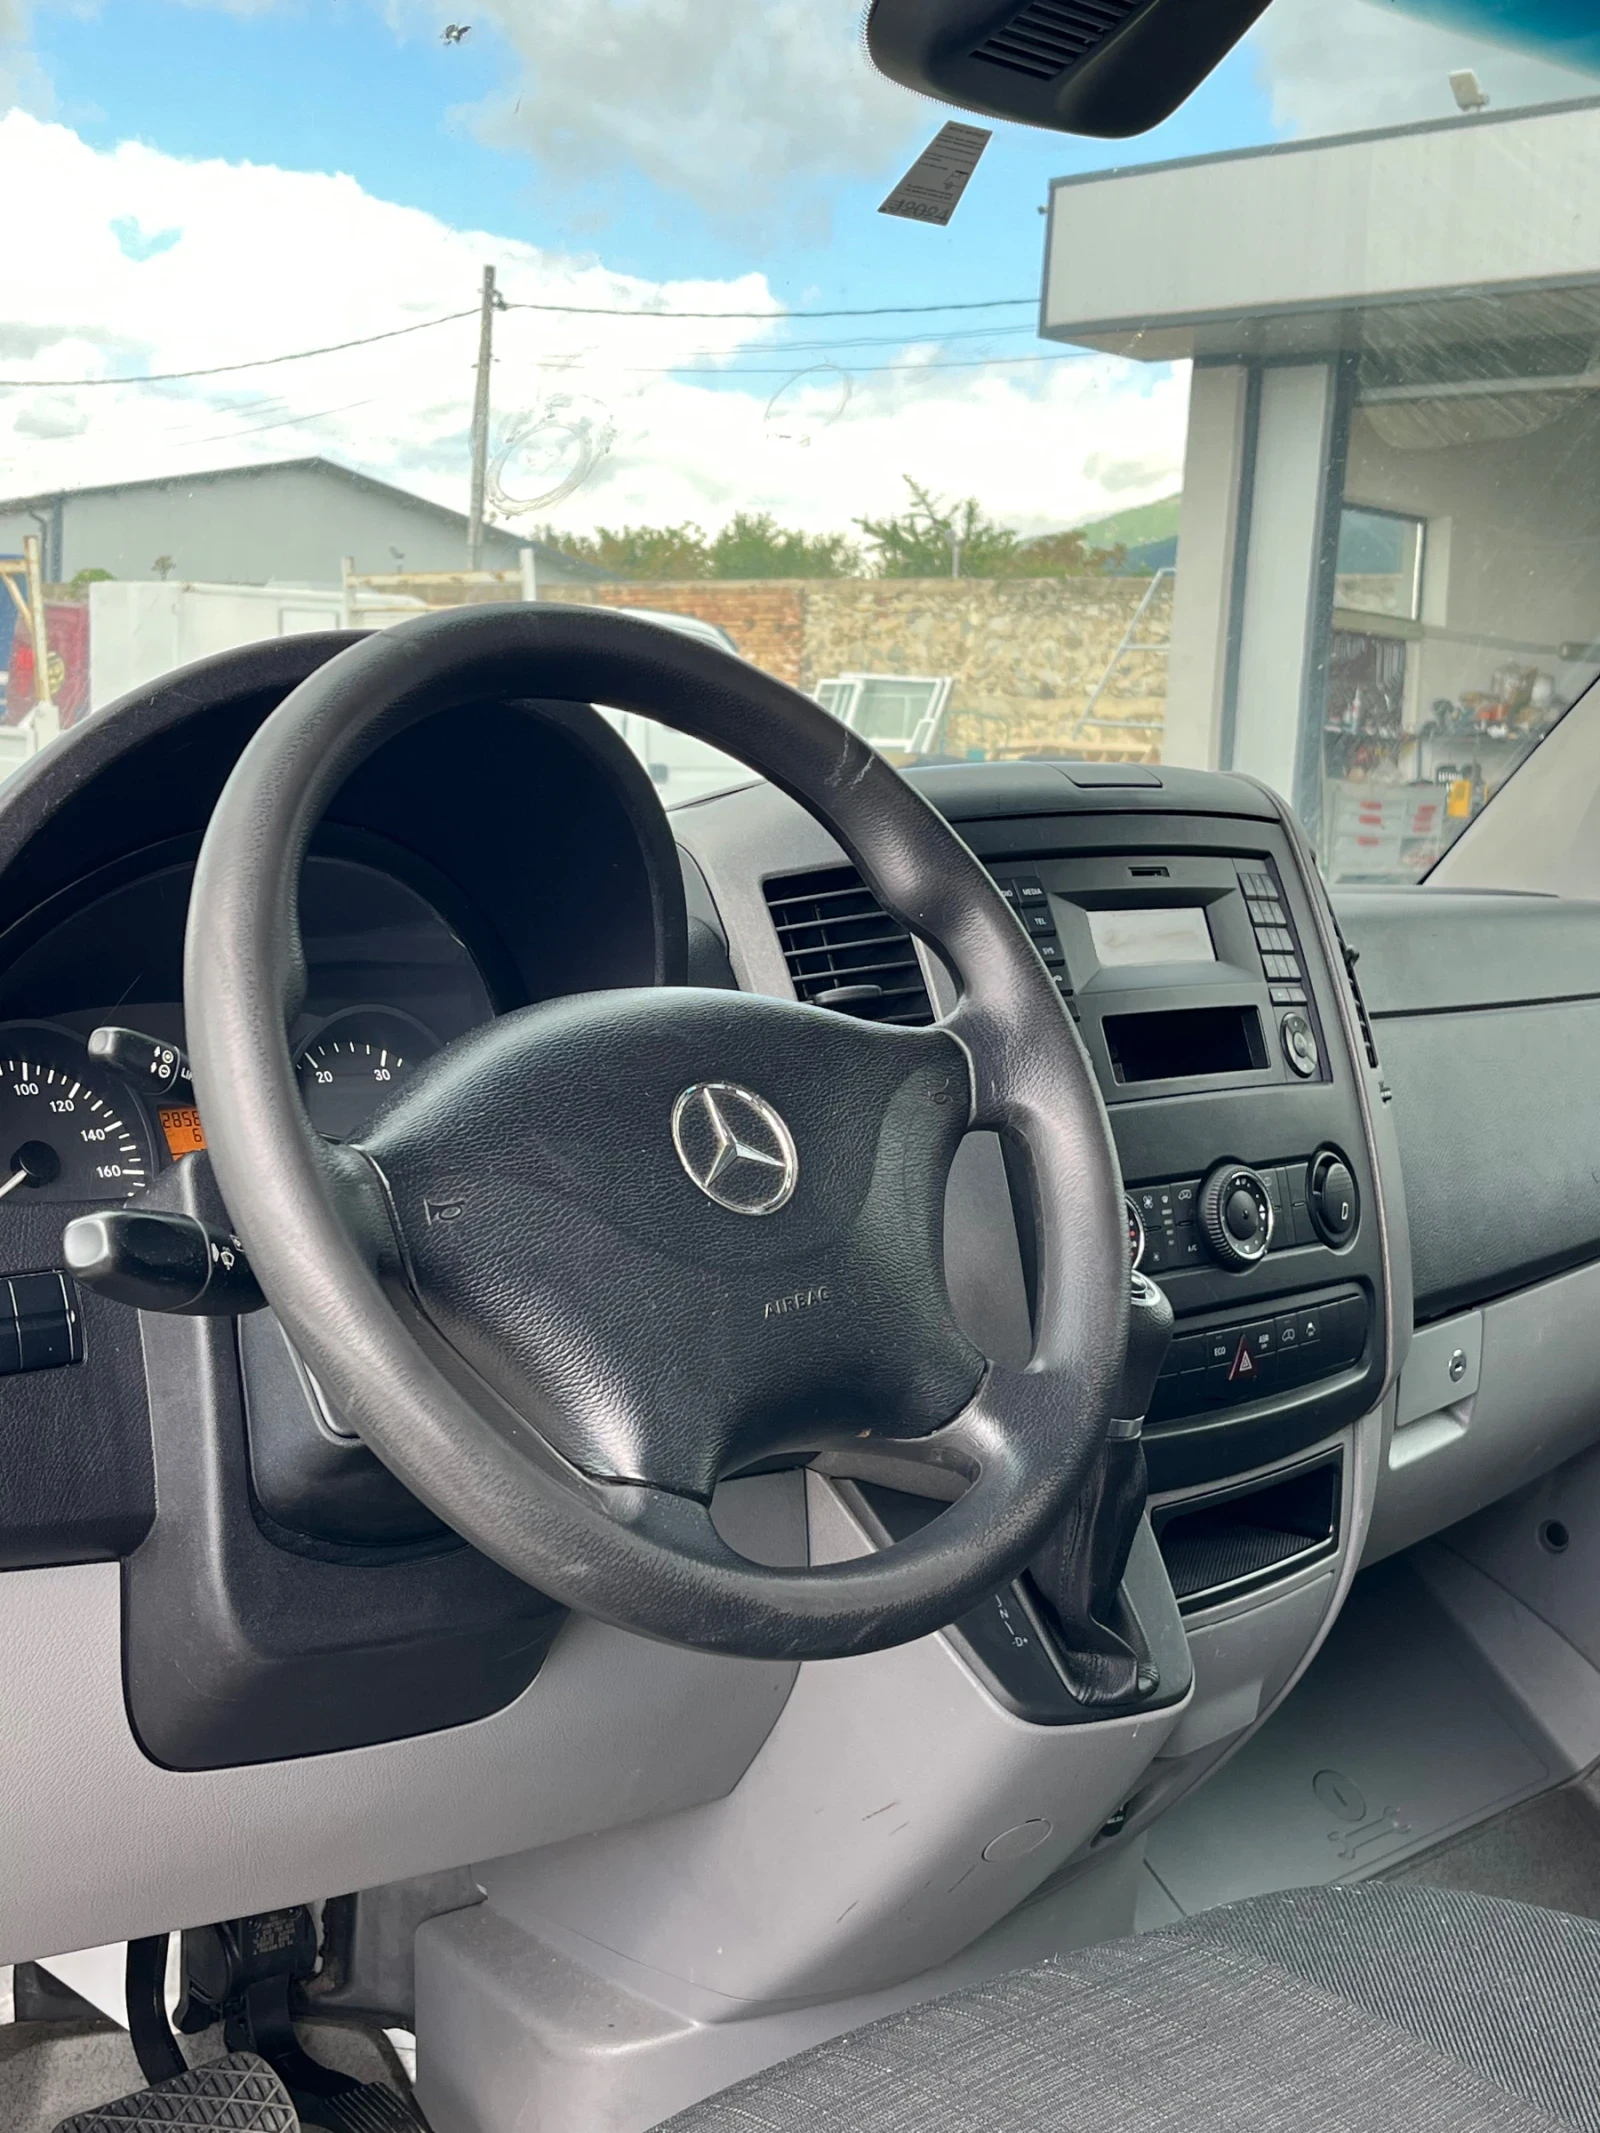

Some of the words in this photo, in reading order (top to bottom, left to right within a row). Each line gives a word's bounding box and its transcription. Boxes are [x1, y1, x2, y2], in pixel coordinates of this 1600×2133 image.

[1034, 917, 1047, 925] TEL
[1042, 947, 1055, 955] SYS
[315, 1070, 333, 1083] 20
[373, 1069, 391, 1081] 30
[13, 1082, 39, 1096] 100
[49, 1099, 75, 1113] 120
[80, 1128, 106, 1142] 140
[96, 1164, 121, 1178] 160
[764, 1286, 830, 1319] AIRBAG
[1214, 1346, 1226, 1356] ECO
